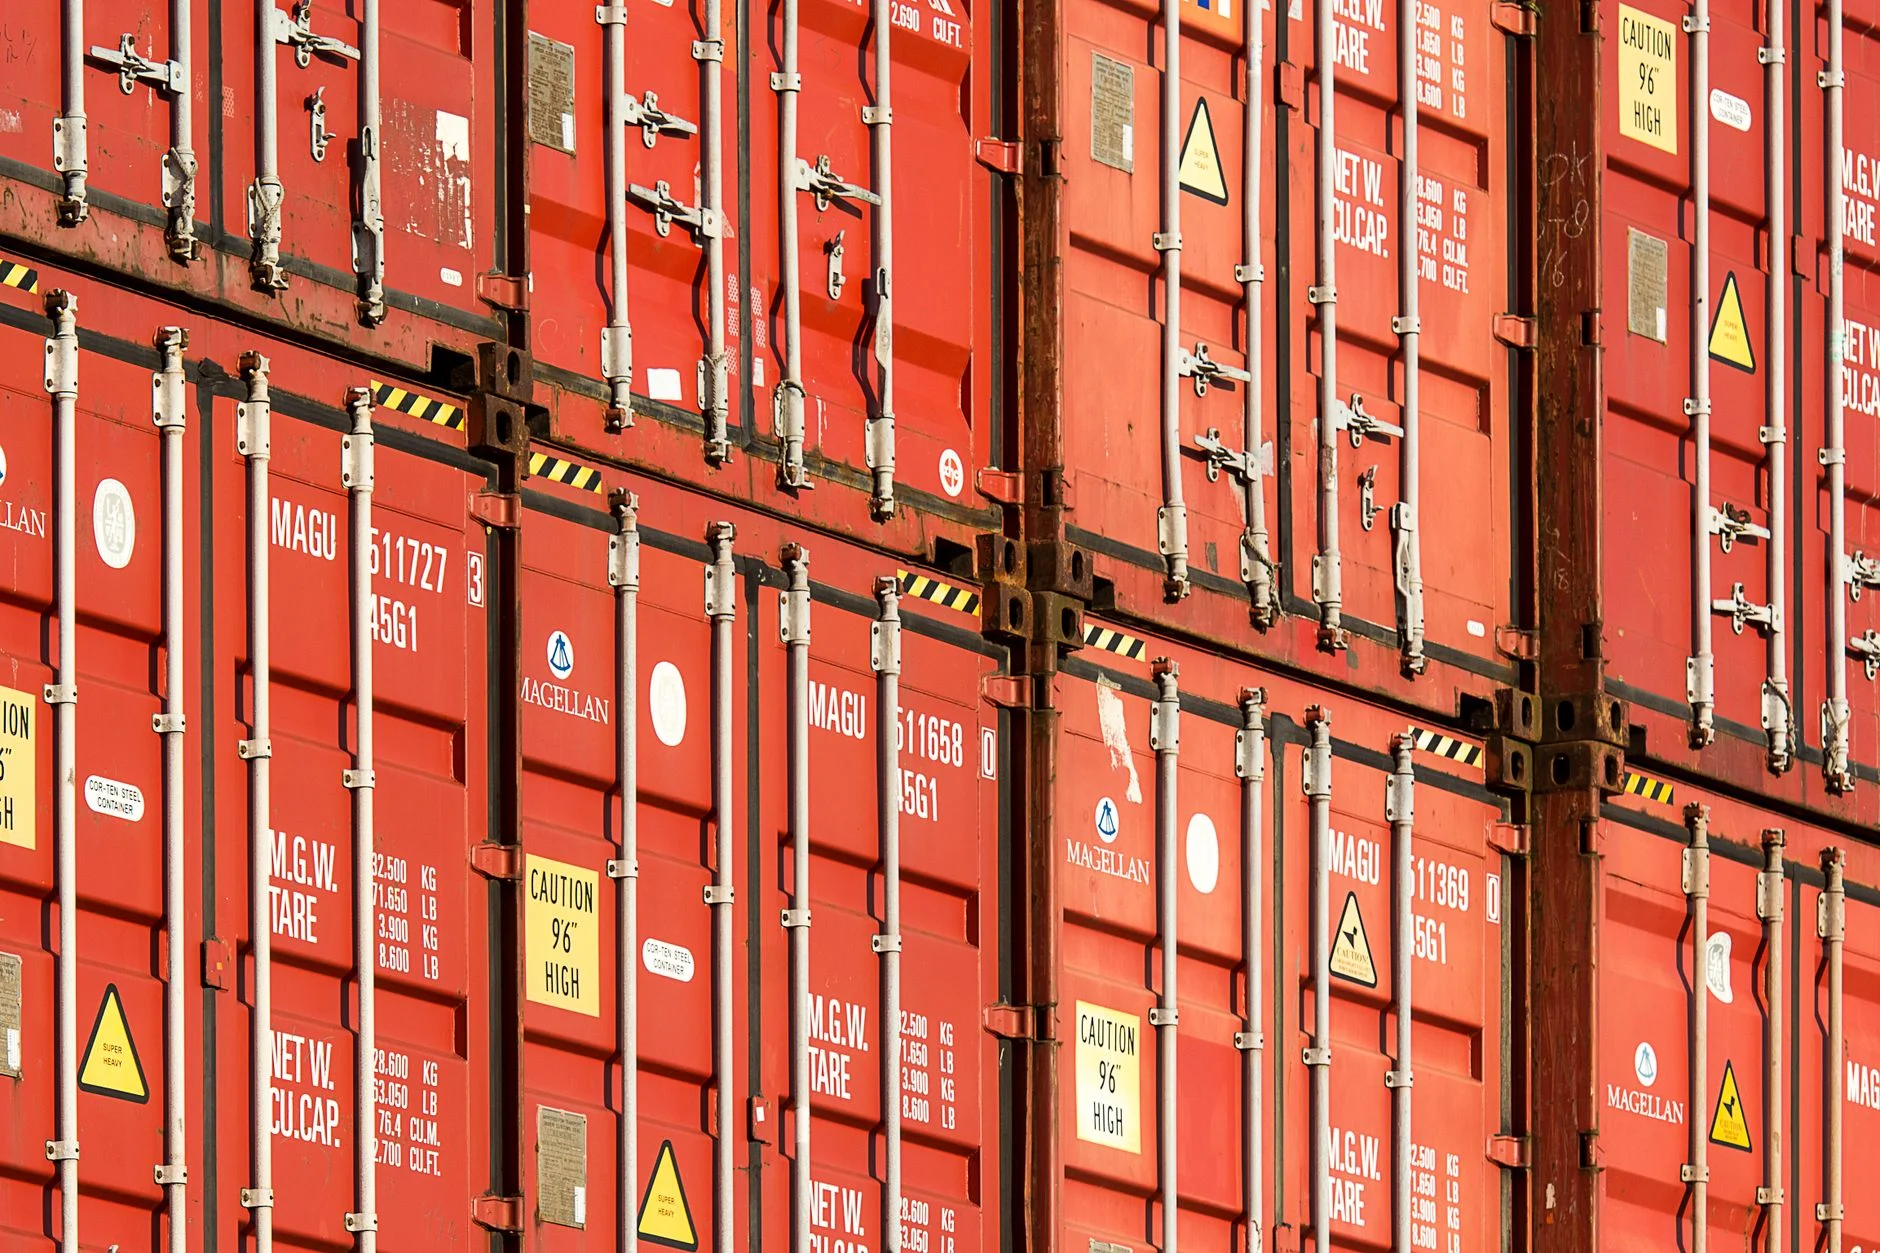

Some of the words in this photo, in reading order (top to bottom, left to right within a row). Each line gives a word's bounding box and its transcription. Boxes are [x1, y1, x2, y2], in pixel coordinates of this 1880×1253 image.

[933, 17, 962, 48] CU.FT.
[1451, 14, 1464, 40] KG
[1622, 17, 1671, 61] CAUTION
[1332, 20, 1369, 75] TARE
[1451, 41, 1464, 66] LB
[1452, 67, 1465, 93] KG
[1452, 93, 1465, 119] LB
[1634, 100, 1661, 136] HIGH
[1332, 147, 1361, 197] NET
[1362, 158, 1384, 208] W.
[1453, 188, 1466, 215] KG
[1332, 196, 1389, 259] CU.CAP.
[1453, 215, 1466, 240] LB
[1841, 194, 1876, 247] TARE
[1417, 227, 1437, 256] 76.4
[1443, 238, 1469, 269] CU.M.
[1442, 264, 1469, 294] CU.FT.
[272, 497, 337, 561] MAGU
[371, 527, 447, 593] 511727
[470, 555, 482, 603] 3
[371, 593, 417, 652] 45G1
[809, 680, 866, 740] MAGU
[88, 779, 119, 797] COR-TEN
[121, 787, 141, 803] STEEL
[97, 796, 134, 815] CONTAINER
[269, 829, 338, 893] M.G.W.
[1066, 838, 1150, 885] MAGELLAN
[1328, 829, 1381, 885] MAGU
[421, 864, 437, 892] KG
[531, 868, 593, 914] CAUTION
[269, 885, 318, 944] TARE
[421, 894, 437, 921] LB
[422, 924, 438, 951] KG
[423, 953, 439, 980] LB
[646, 942, 672, 958] COR-TEN
[674, 950, 692, 964] STEEL
[653, 958, 685, 975] CONTAINER
[545, 961, 580, 999] HIGH
[807, 992, 869, 1051] M.G.W.
[939, 1021, 954, 1047] KG
[1081, 1014, 1135, 1057] CAUTION
[103, 1042, 123, 1055] SUPER
[103, 1057, 123, 1069] HEAVY
[270, 1029, 305, 1083] NET
[309, 1038, 335, 1091] W.
[940, 1048, 954, 1074] LB
[422, 1060, 438, 1087] KG
[808, 1046, 851, 1100] TARE
[422, 1089, 437, 1116] LB
[940, 1077, 955, 1103] KG
[1607, 1084, 1684, 1124] MAGELLAN
[270, 1087, 341, 1148] CU.CAP.
[377, 1108, 402, 1138] 76.4
[409, 1116, 441, 1147] CU.M.
[941, 1104, 956, 1130] LB
[1093, 1101, 1123, 1137] HIGH
[409, 1146, 441, 1177] CU.FT.
[1328, 1126, 1381, 1181] M.G.W.
[1446, 1153, 1459, 1178] KG
[658, 1194, 676, 1205] SUPER
[1328, 1176, 1365, 1227] TARE
[1446, 1180, 1459, 1204] LB
[657, 1208, 675, 1219] HEAVY
[809, 1179, 839, 1230] NET
[841, 1187, 865, 1237] W.
[941, 1207, 955, 1233] KG
[1447, 1206, 1460, 1230] KG
